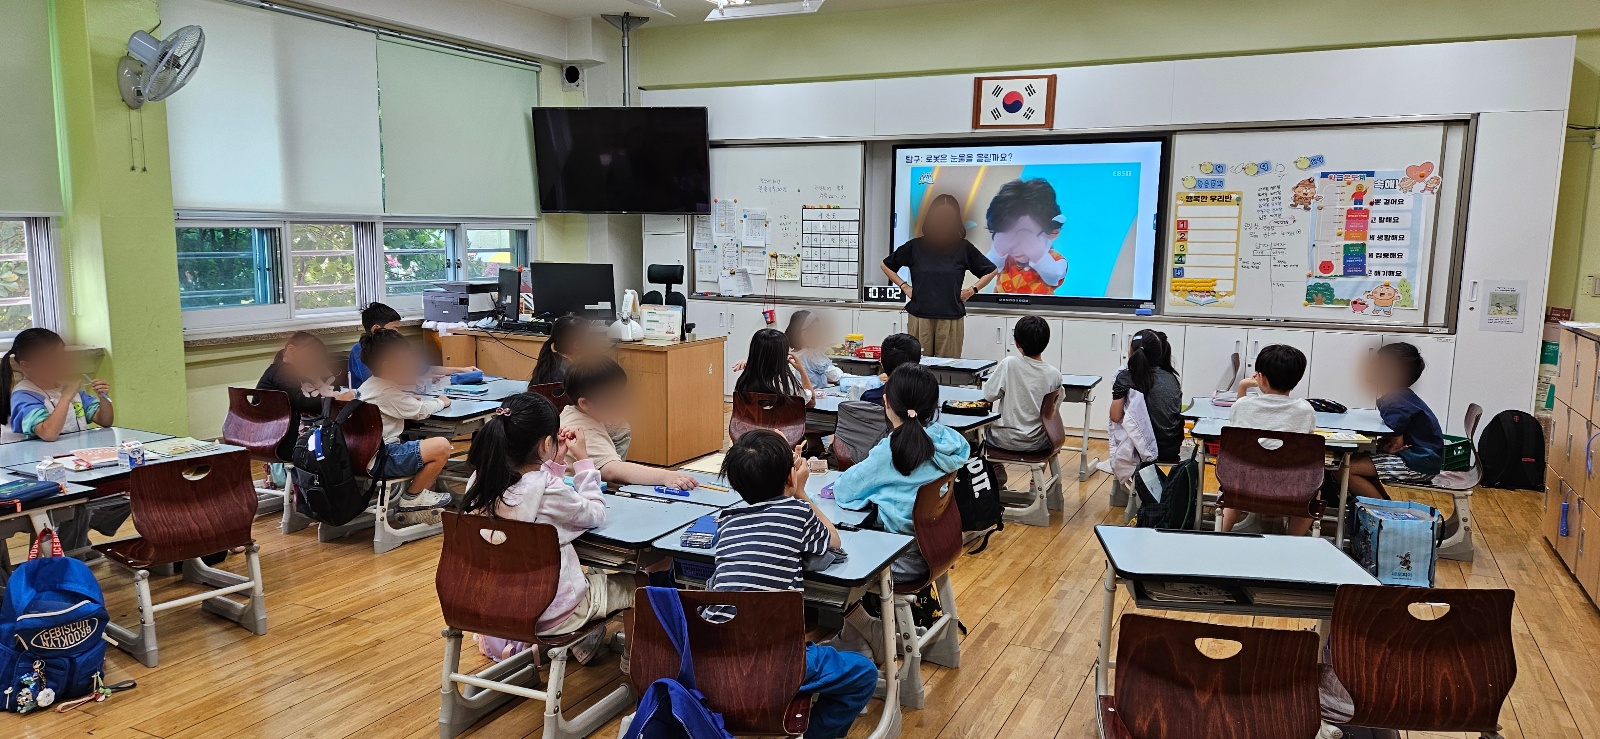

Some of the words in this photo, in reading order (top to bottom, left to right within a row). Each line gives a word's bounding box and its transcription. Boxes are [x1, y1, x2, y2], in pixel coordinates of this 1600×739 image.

[925, 154, 948, 163] 로봇은
[950, 153, 974, 163] 눈물을
[976, 152, 1013, 162] 흘릴까요?
[1185, 195, 1209, 203] 행복한
[1209, 194, 1233, 203] 우리반
[1383, 198, 1405, 206] 걸어요
[1378, 216, 1400, 224] 말해요
[1376, 234, 1405, 242] 생활해요
[868, 287, 902, 300] 10:02
[40, 619, 90, 646] ICEBISCUIT
[42, 625, 92, 648] BROOKLYN
